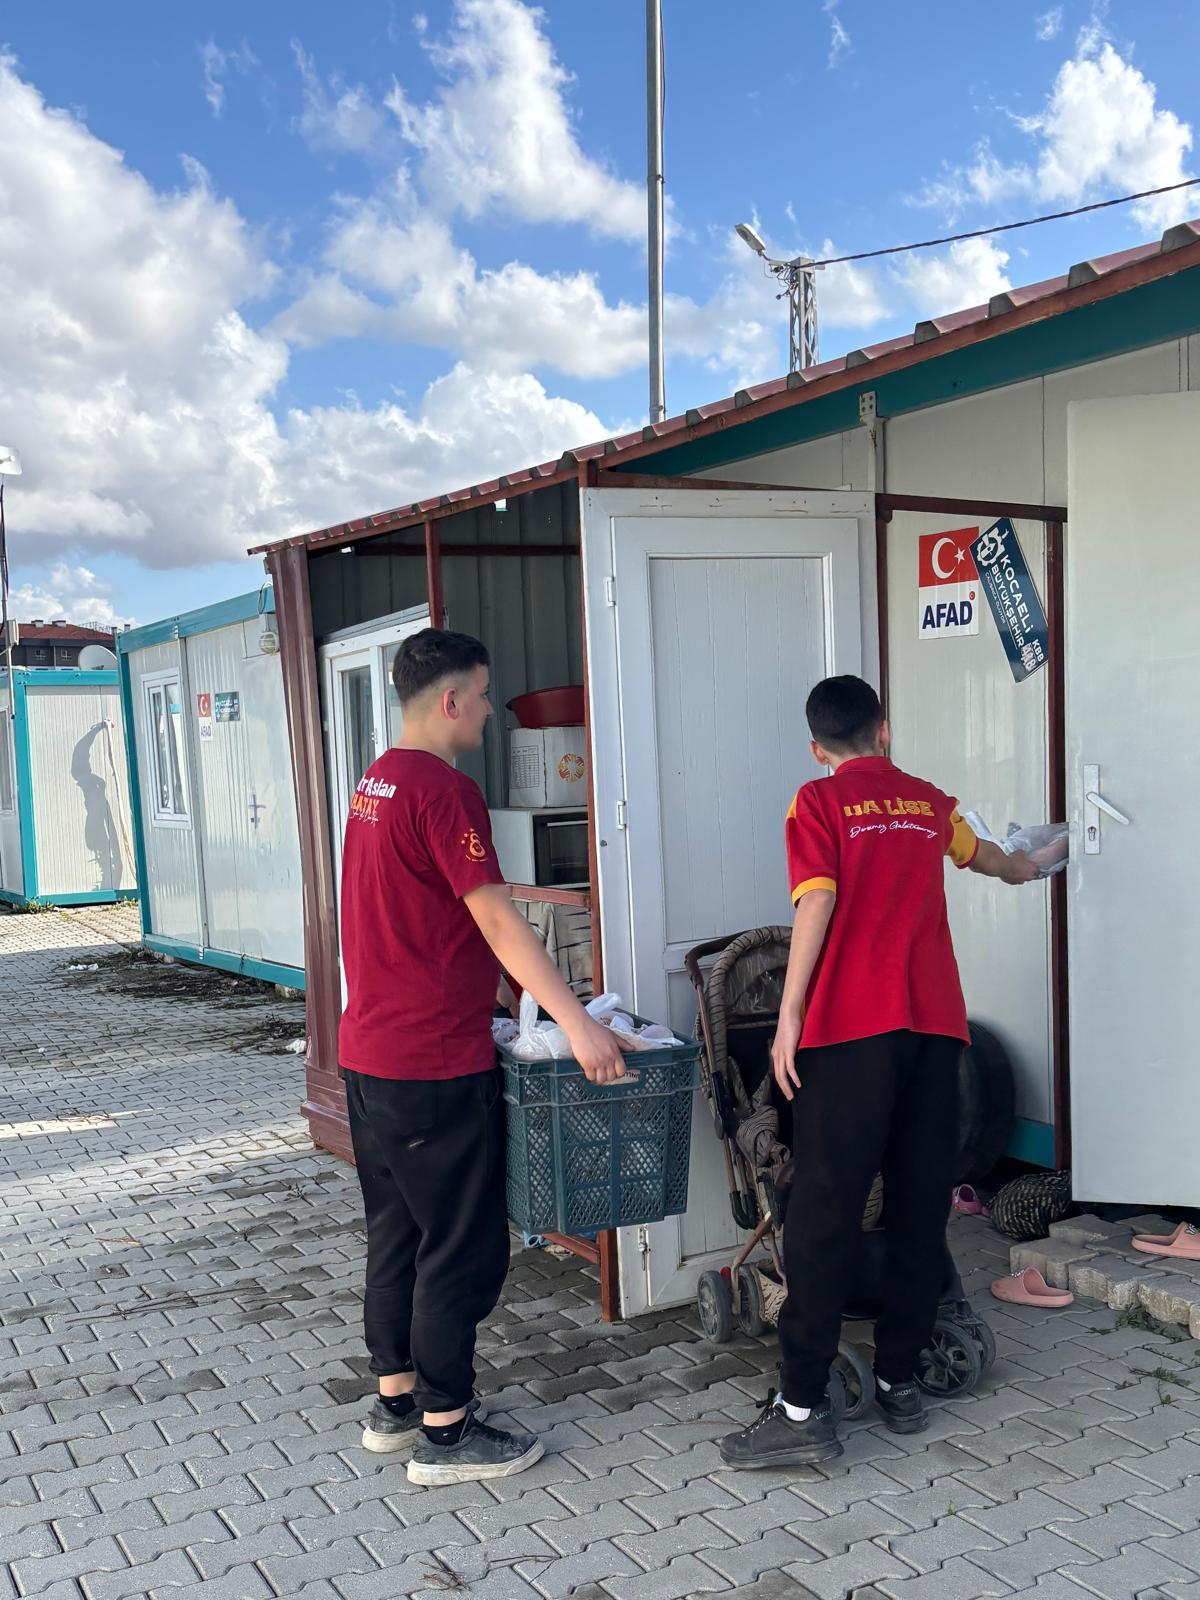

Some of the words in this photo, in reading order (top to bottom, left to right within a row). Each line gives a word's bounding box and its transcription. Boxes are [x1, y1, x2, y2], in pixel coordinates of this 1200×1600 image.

[991, 564, 1025, 647] BÜYÜKŞEHİR
[1000, 555, 1034, 633] KOCAELİ
[922, 600, 973, 629] AFAD
[1032, 639, 1044, 662] KBB
[883, 797, 935, 817] LİSE
